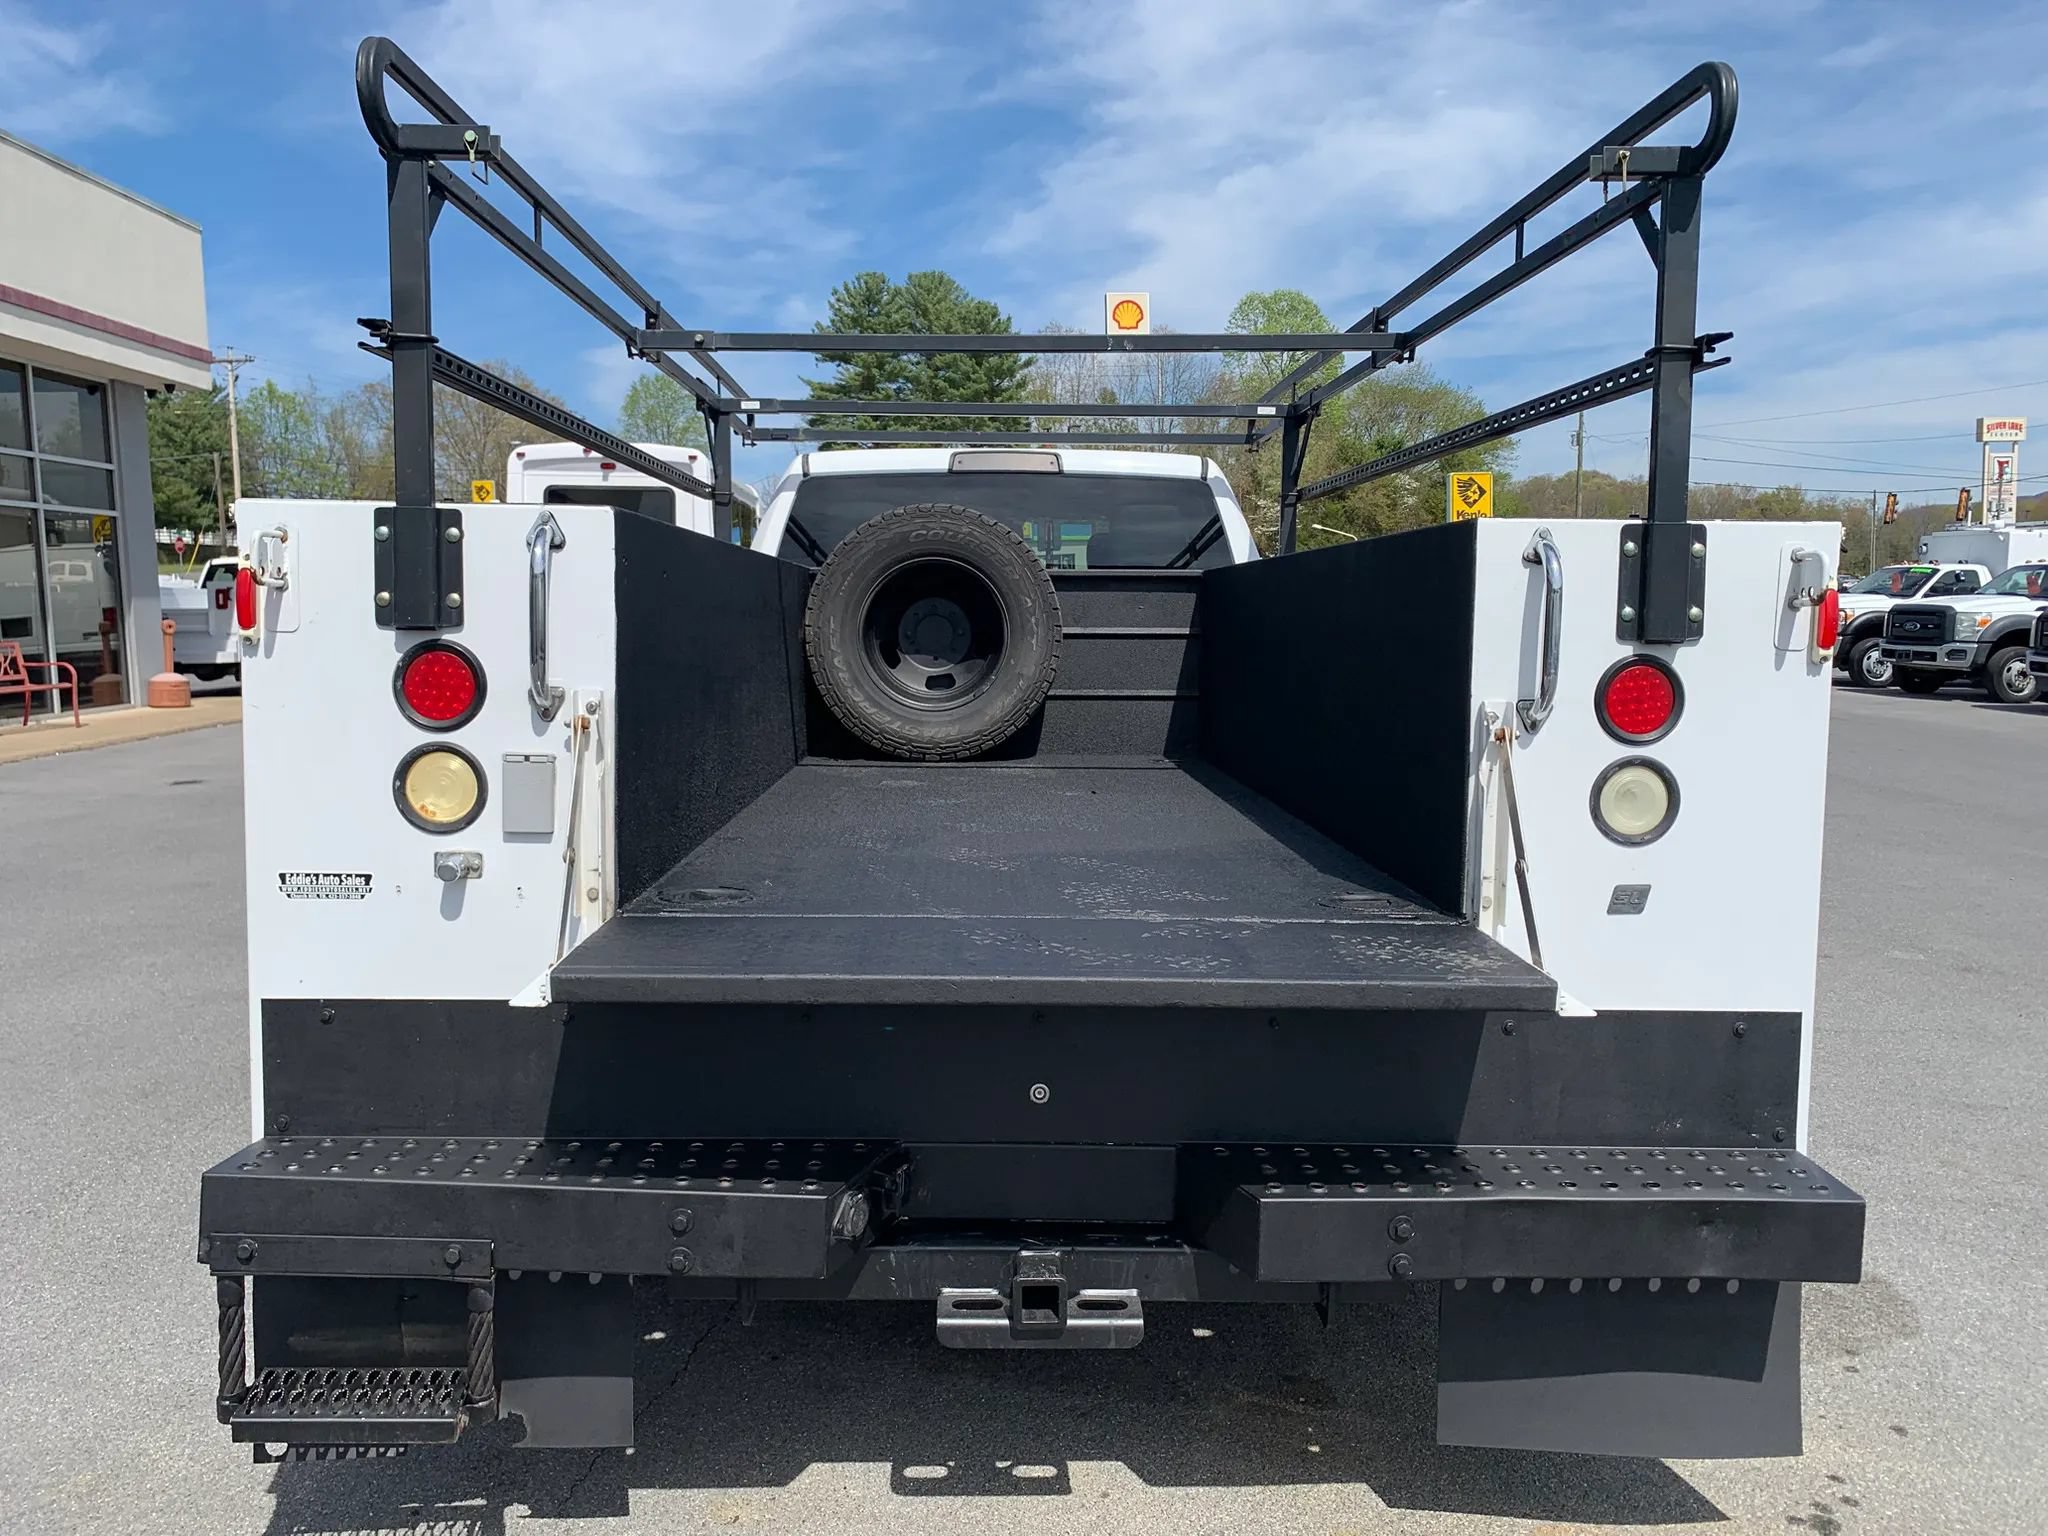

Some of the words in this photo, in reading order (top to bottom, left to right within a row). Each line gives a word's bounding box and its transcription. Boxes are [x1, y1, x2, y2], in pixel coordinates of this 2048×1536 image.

[2008, 421, 2023, 432] LAKE
[285, 873, 317, 885] Eddie's
[318, 873, 340, 885] Auto
[341, 874, 366, 886] Sales
